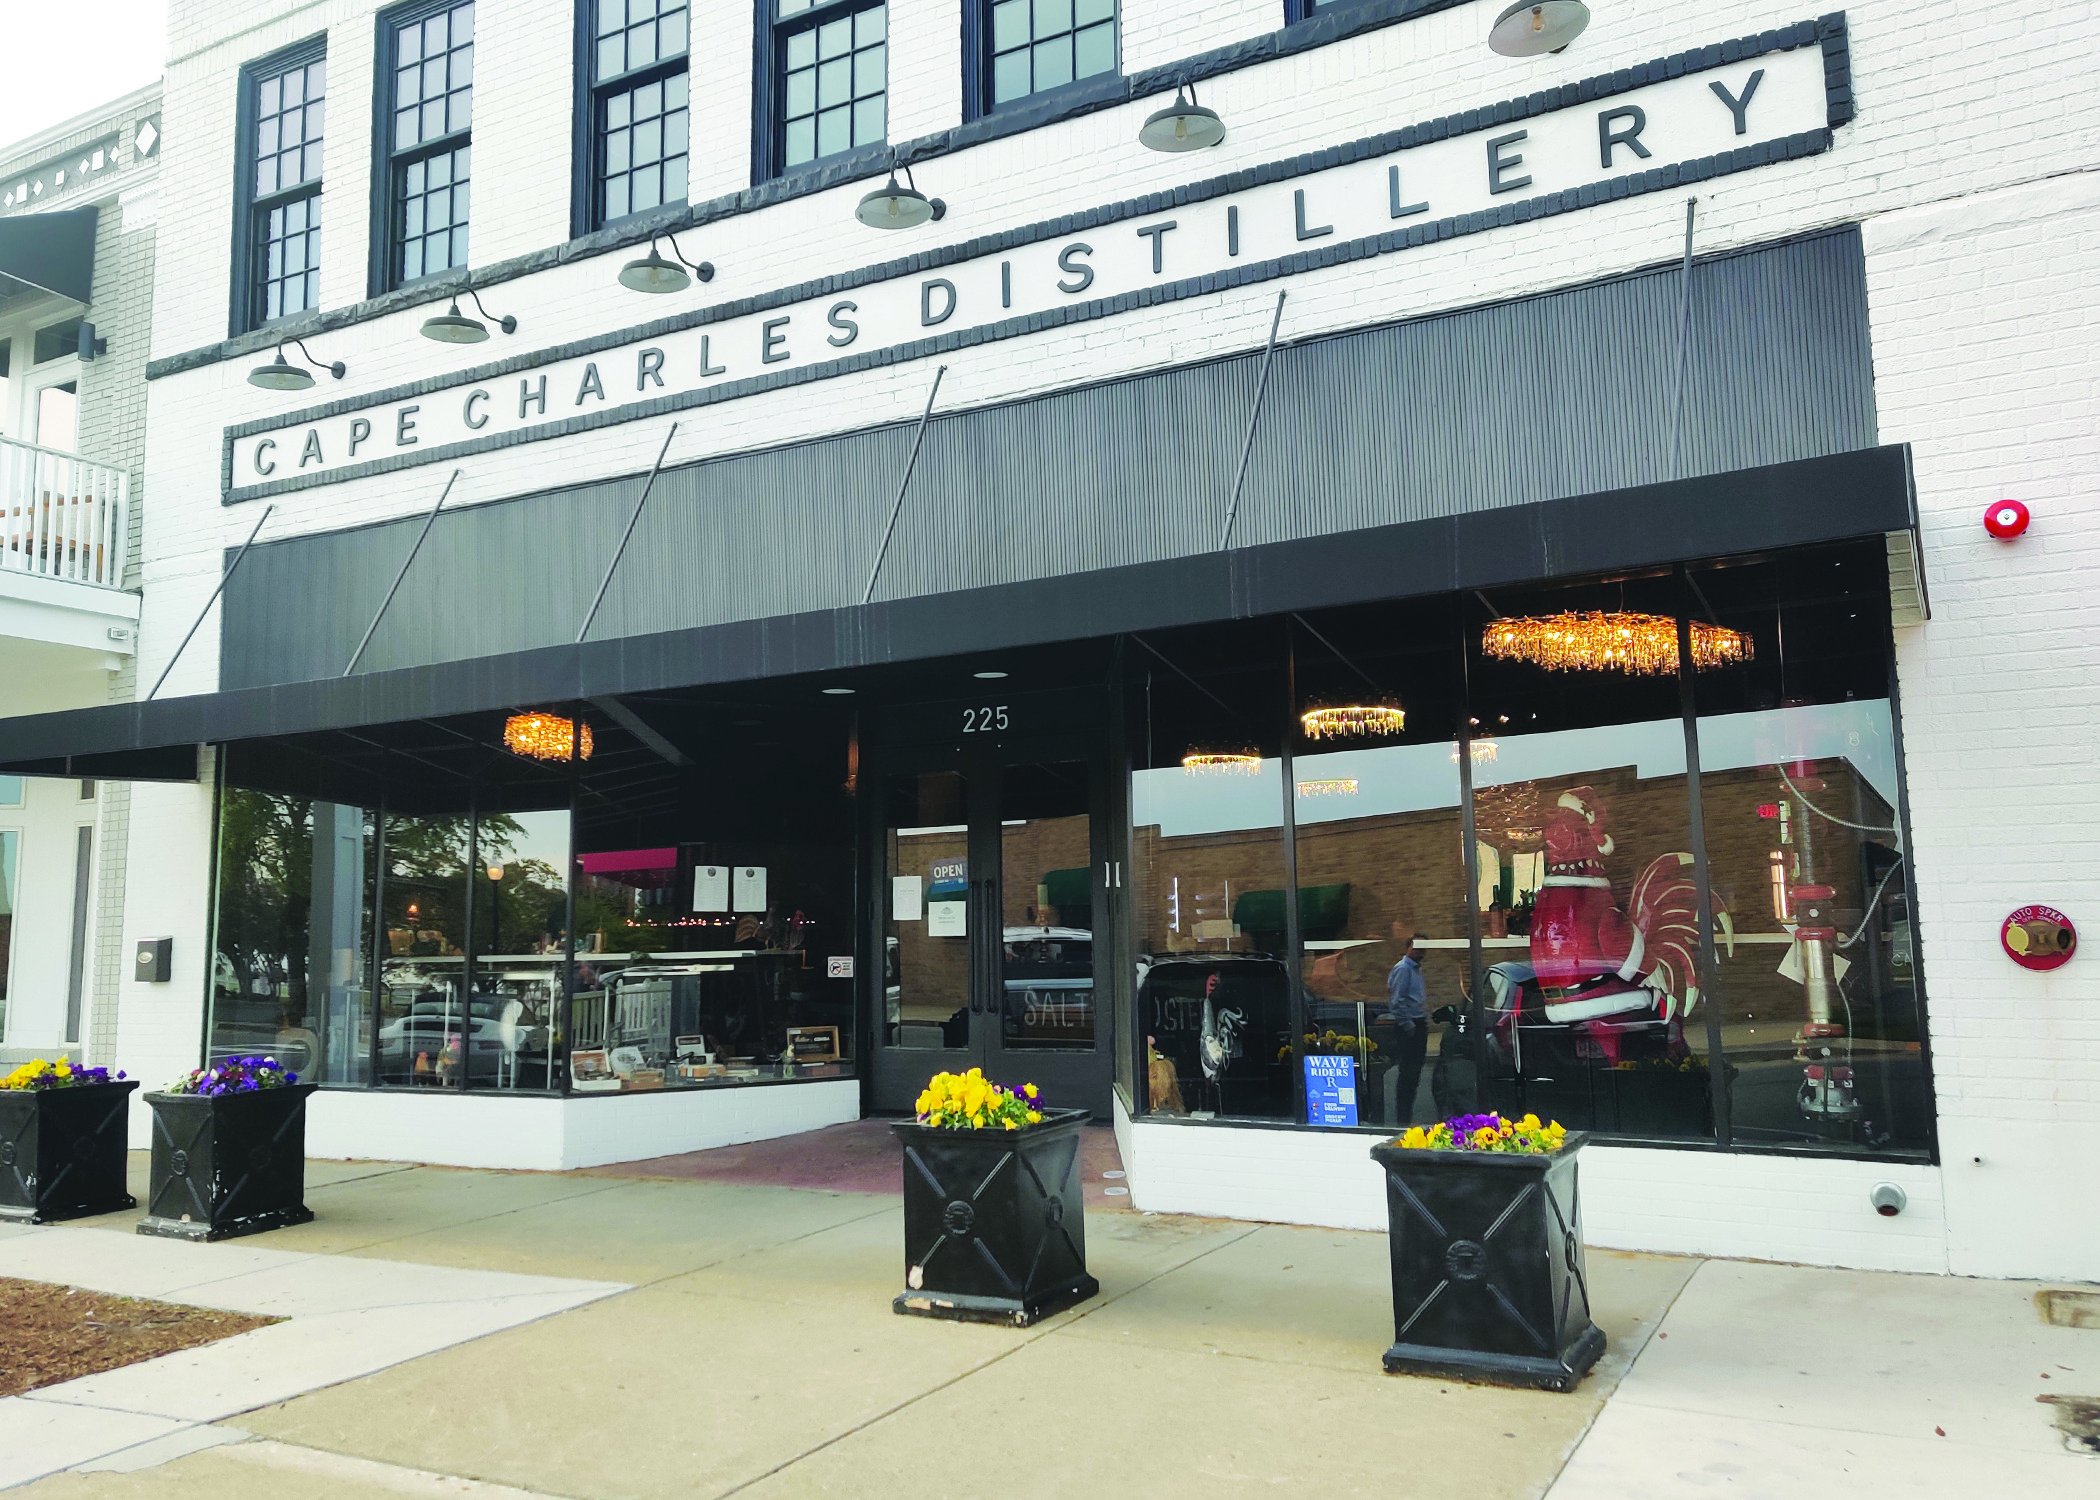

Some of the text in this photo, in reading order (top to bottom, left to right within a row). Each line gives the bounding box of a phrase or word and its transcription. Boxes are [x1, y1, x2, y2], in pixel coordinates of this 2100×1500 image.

[253, 69, 1765, 476] CAPE CHARLES DISTILLERY
[962, 705, 1009, 733] 225
[933, 863, 963, 878] OPEN
[2009, 907, 2064, 924] AUTO SPKR
[1309, 1056, 1349, 1068] WAVE
[1311, 1068, 1349, 1077] RIDERS
[1326, 1077, 1338, 1088] R
